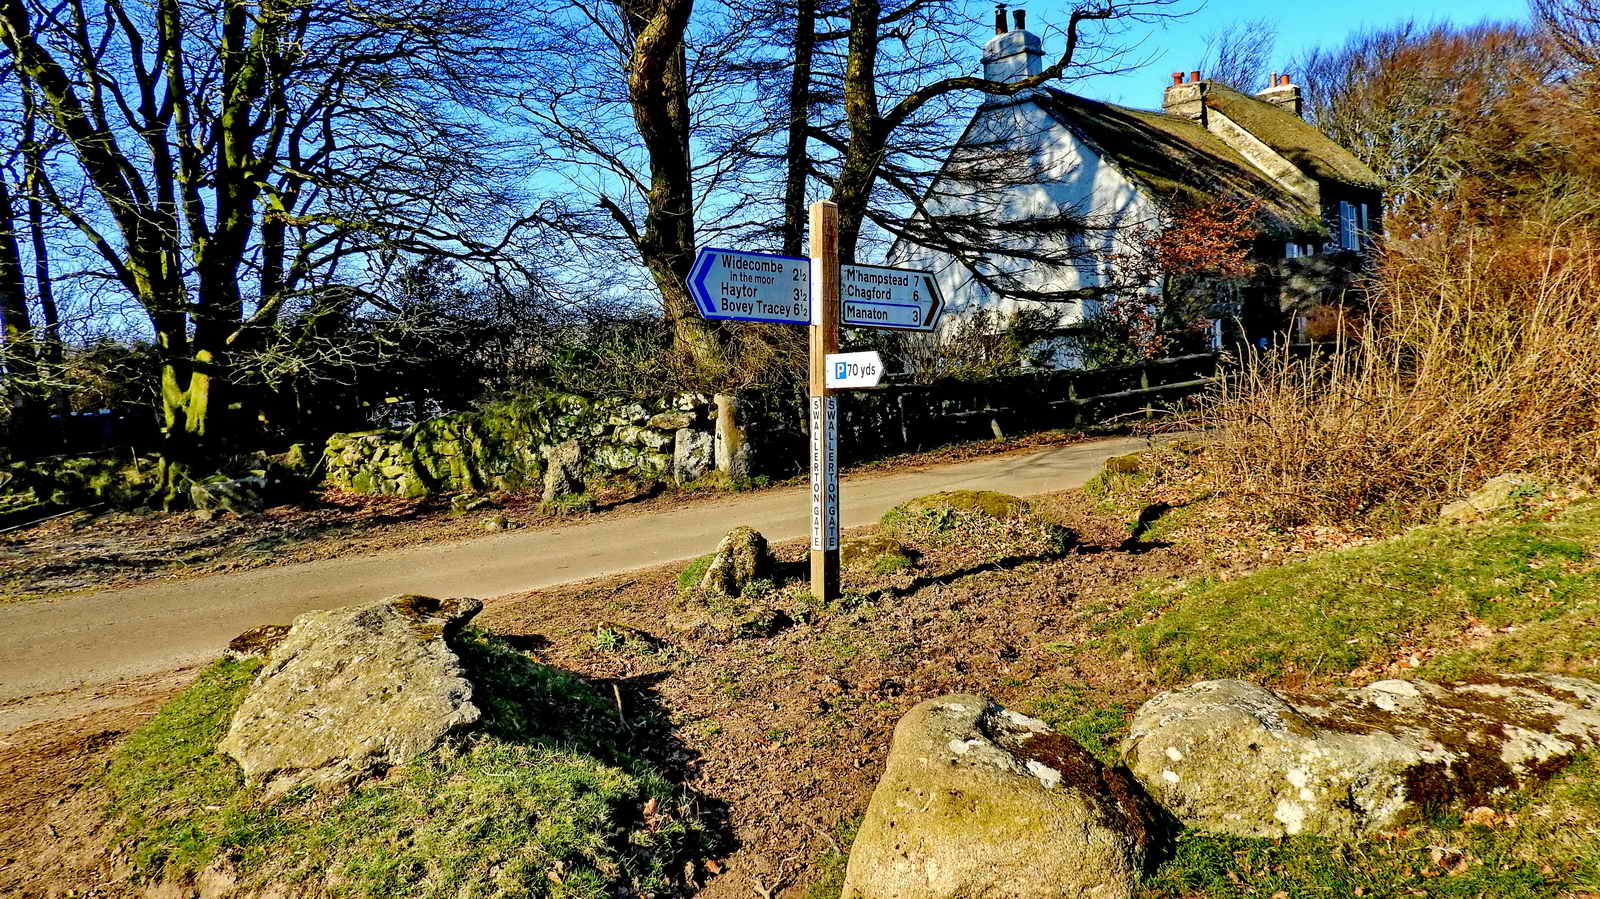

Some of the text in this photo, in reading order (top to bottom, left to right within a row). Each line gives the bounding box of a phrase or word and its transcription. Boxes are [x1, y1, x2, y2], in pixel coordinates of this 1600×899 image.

[721, 254, 784, 273] Widecombe
[730, 271, 775, 285] in the moor
[847, 269, 919, 287] M'hampstead 7
[721, 282, 758, 298] Haytor
[847, 285, 919, 302] Chagford 6
[721, 298, 753, 315] Bovey
[756, 300, 791, 317] Tracey
[847, 306, 919, 322] Manaton 3
[847, 364, 858, 376] 70
[860, 363, 876, 378] yds
